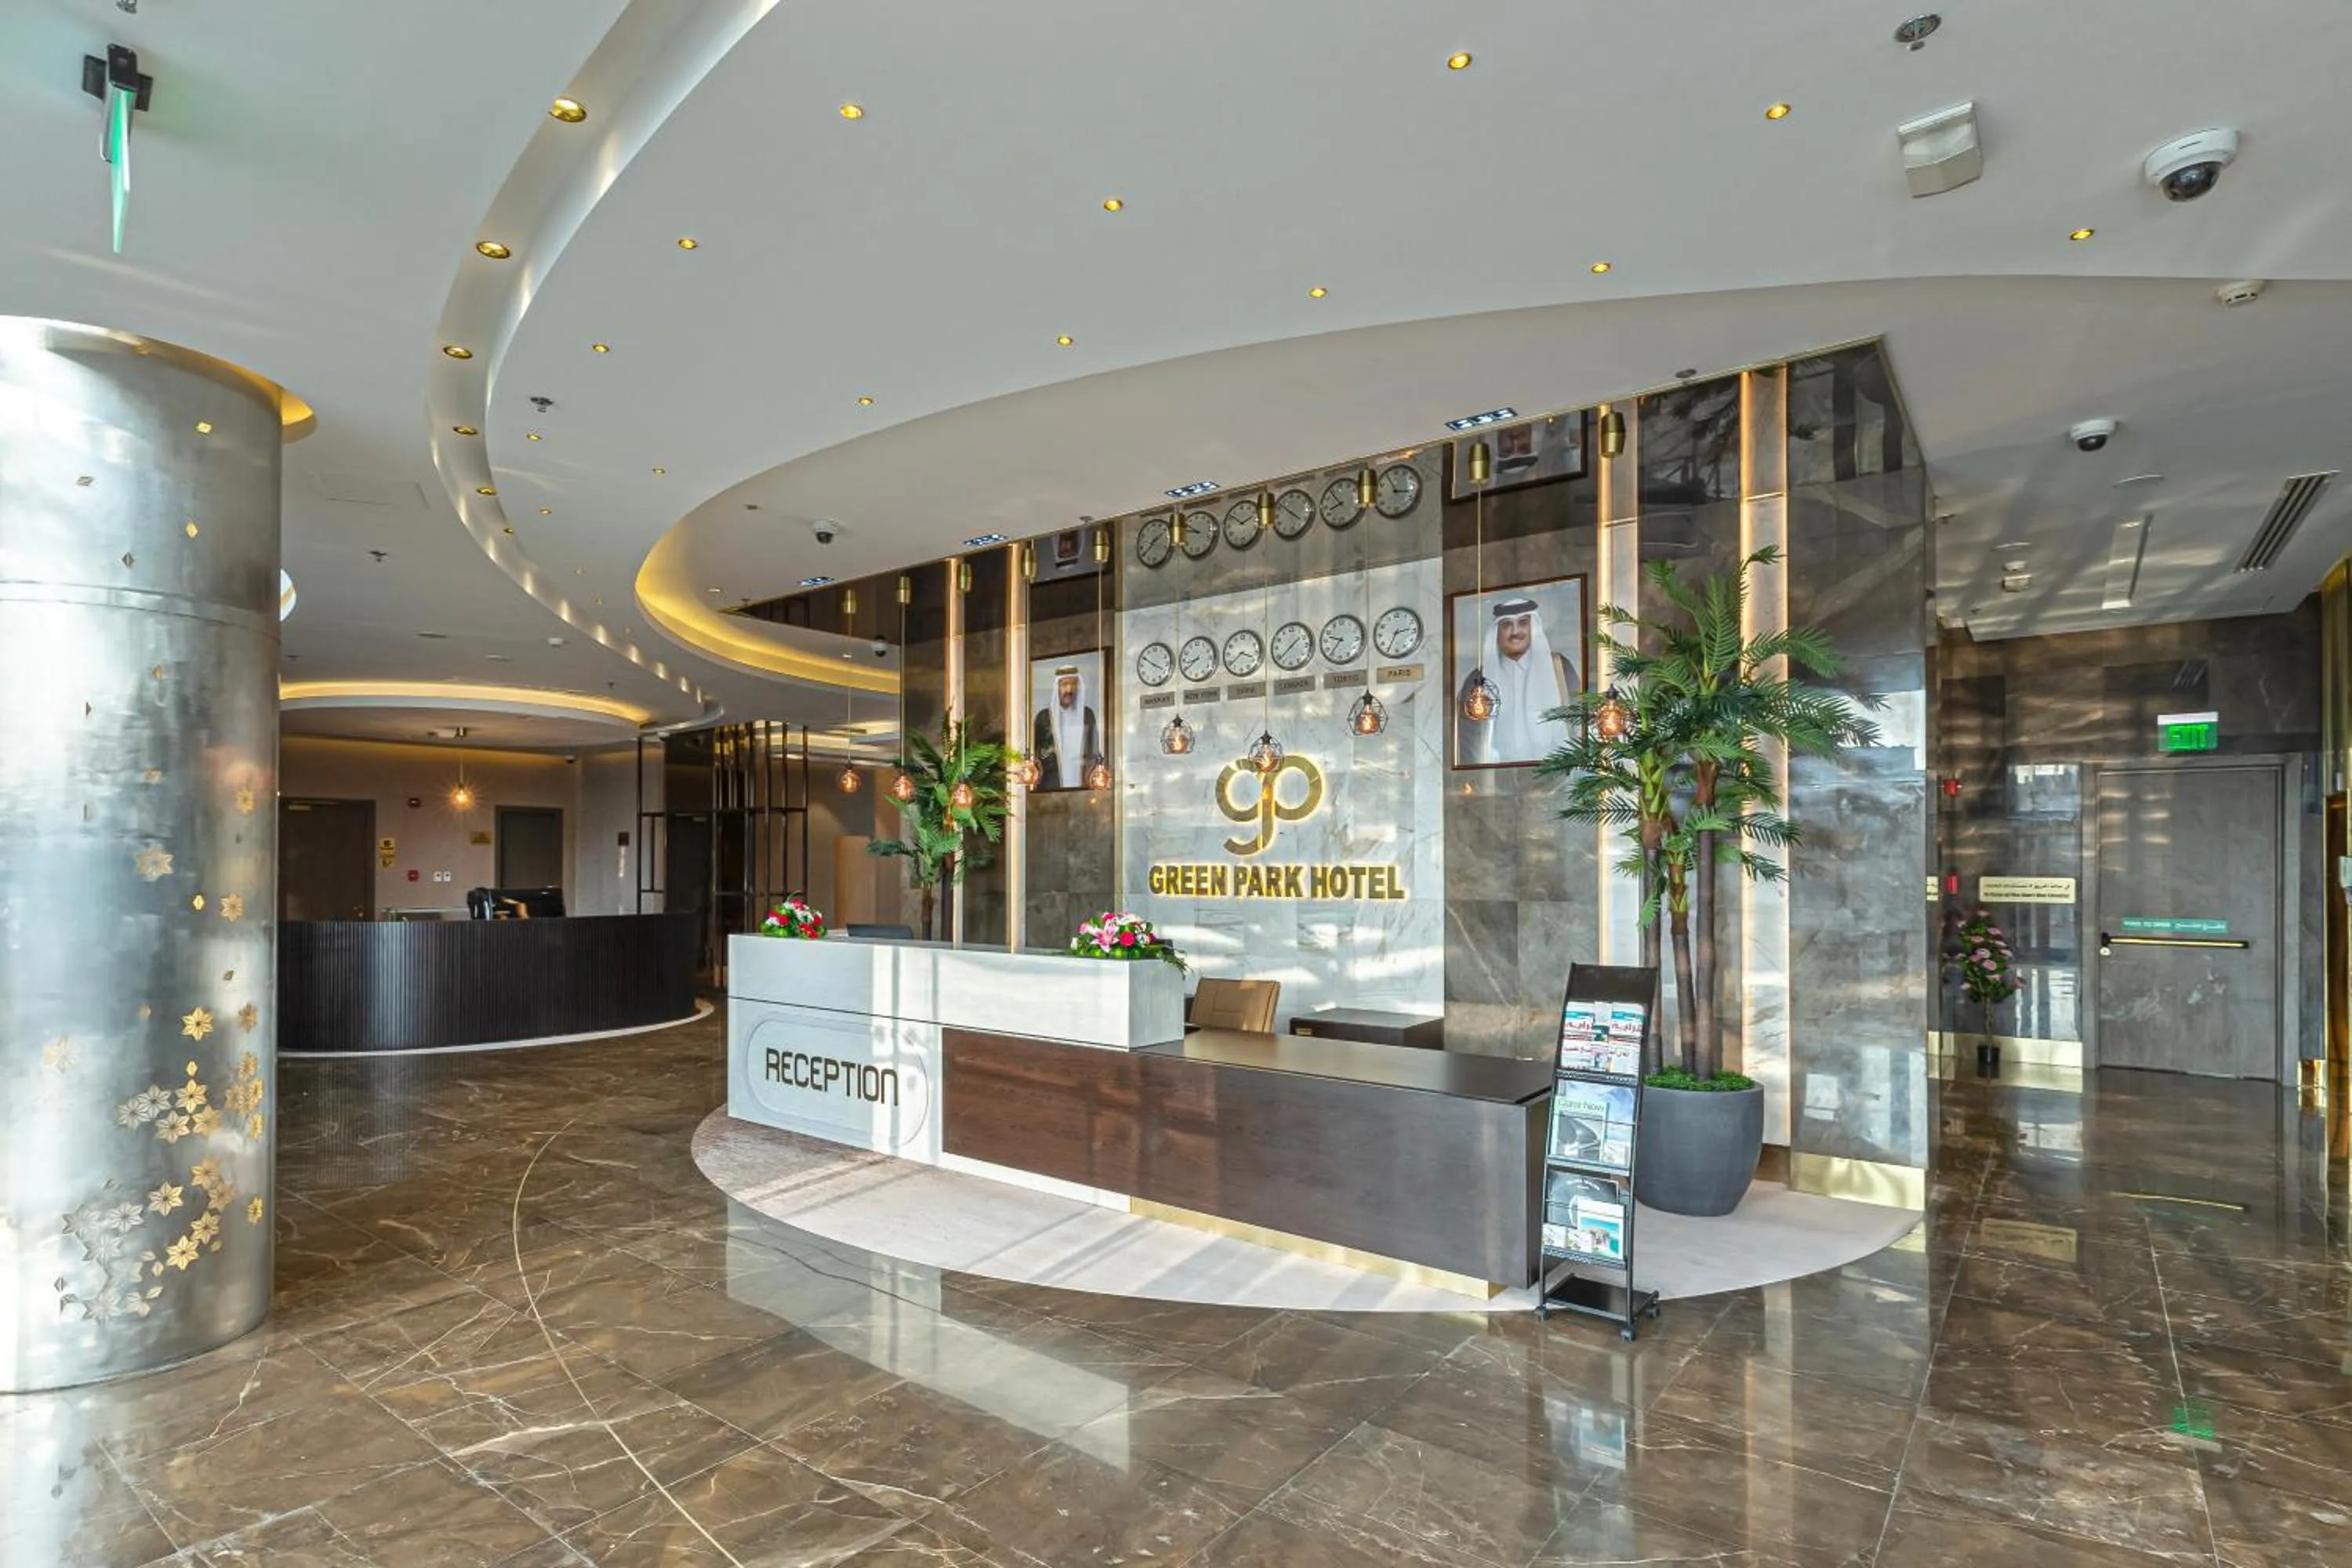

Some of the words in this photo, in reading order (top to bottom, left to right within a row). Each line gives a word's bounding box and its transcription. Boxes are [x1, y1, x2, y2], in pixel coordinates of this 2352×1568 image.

[1387, 668, 1413, 679] PARIS
[2168, 724, 2208, 749] EXIT
[1148, 865, 1226, 896] GREEN
[1233, 865, 1308, 898] PARK
[1309, 865, 1406, 900] HOTEL
[765, 1047, 899, 1107] RECEPTION
